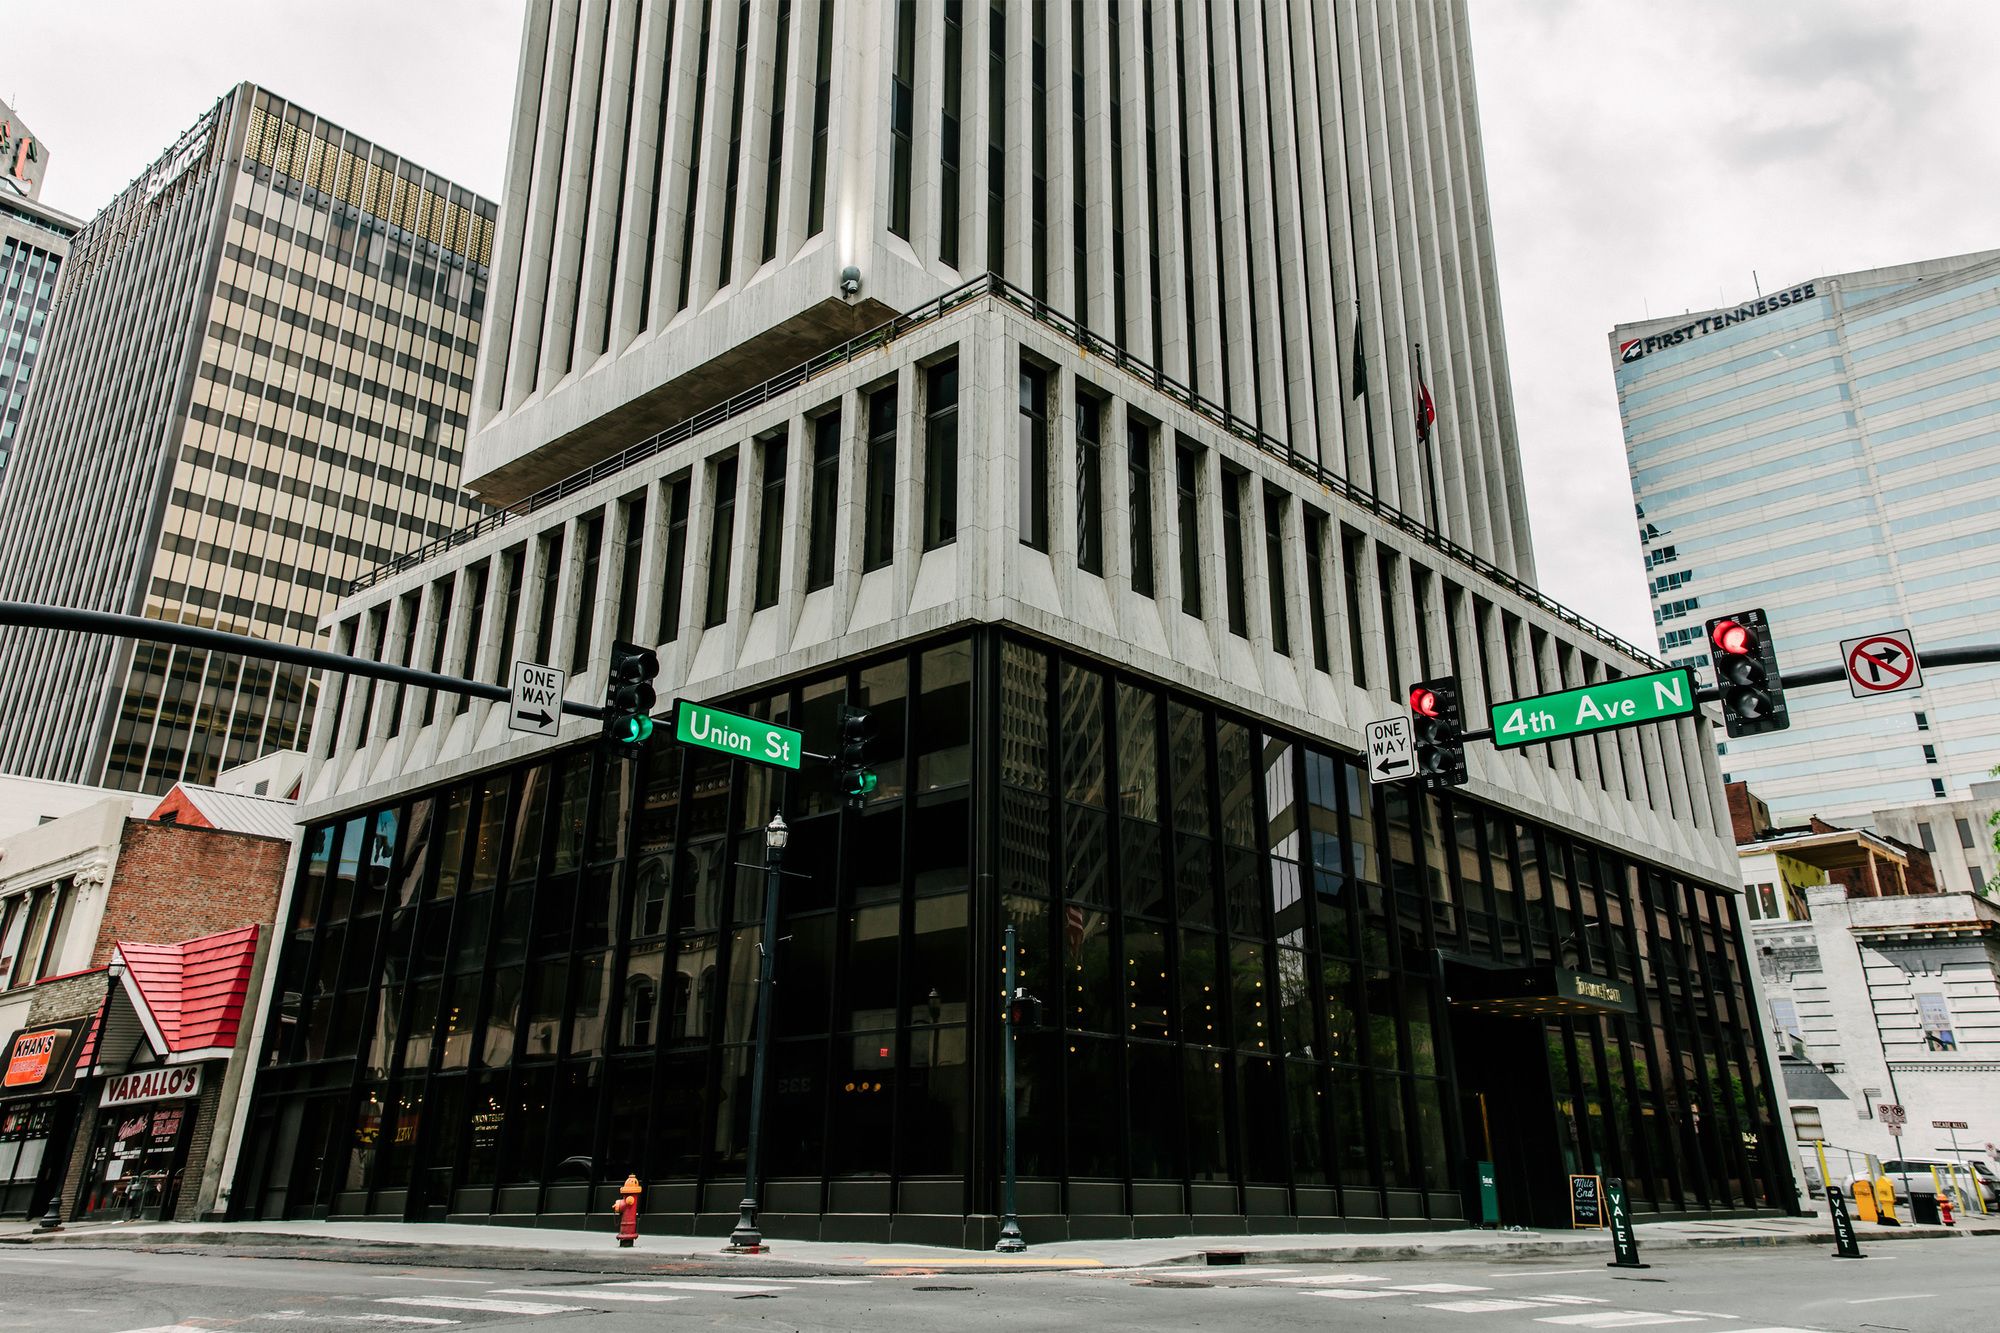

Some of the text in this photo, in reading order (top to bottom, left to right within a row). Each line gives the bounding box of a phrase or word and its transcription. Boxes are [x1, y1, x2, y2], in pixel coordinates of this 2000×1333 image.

[144, 136, 207, 204] source
[1643, 283, 1816, 354] FIRST TENNESSEE
[523, 668, 556, 689] ONE
[522, 686, 556, 707] WAY
[1502, 677, 1684, 737] 4th Ave N
[690, 711, 790, 761] Union St
[1374, 721, 1403, 740] ONE
[1372, 737, 1406, 756] WAY
[14, 1035, 54, 1057] KHAN'S
[108, 1067, 198, 1102] VARALLO'S
[1574, 1178, 1594, 1188] Mile
[1576, 1188, 1594, 1198] End
[1611, 1194, 1628, 1255] VALET
[1832, 1199, 1849, 1248] VALET
